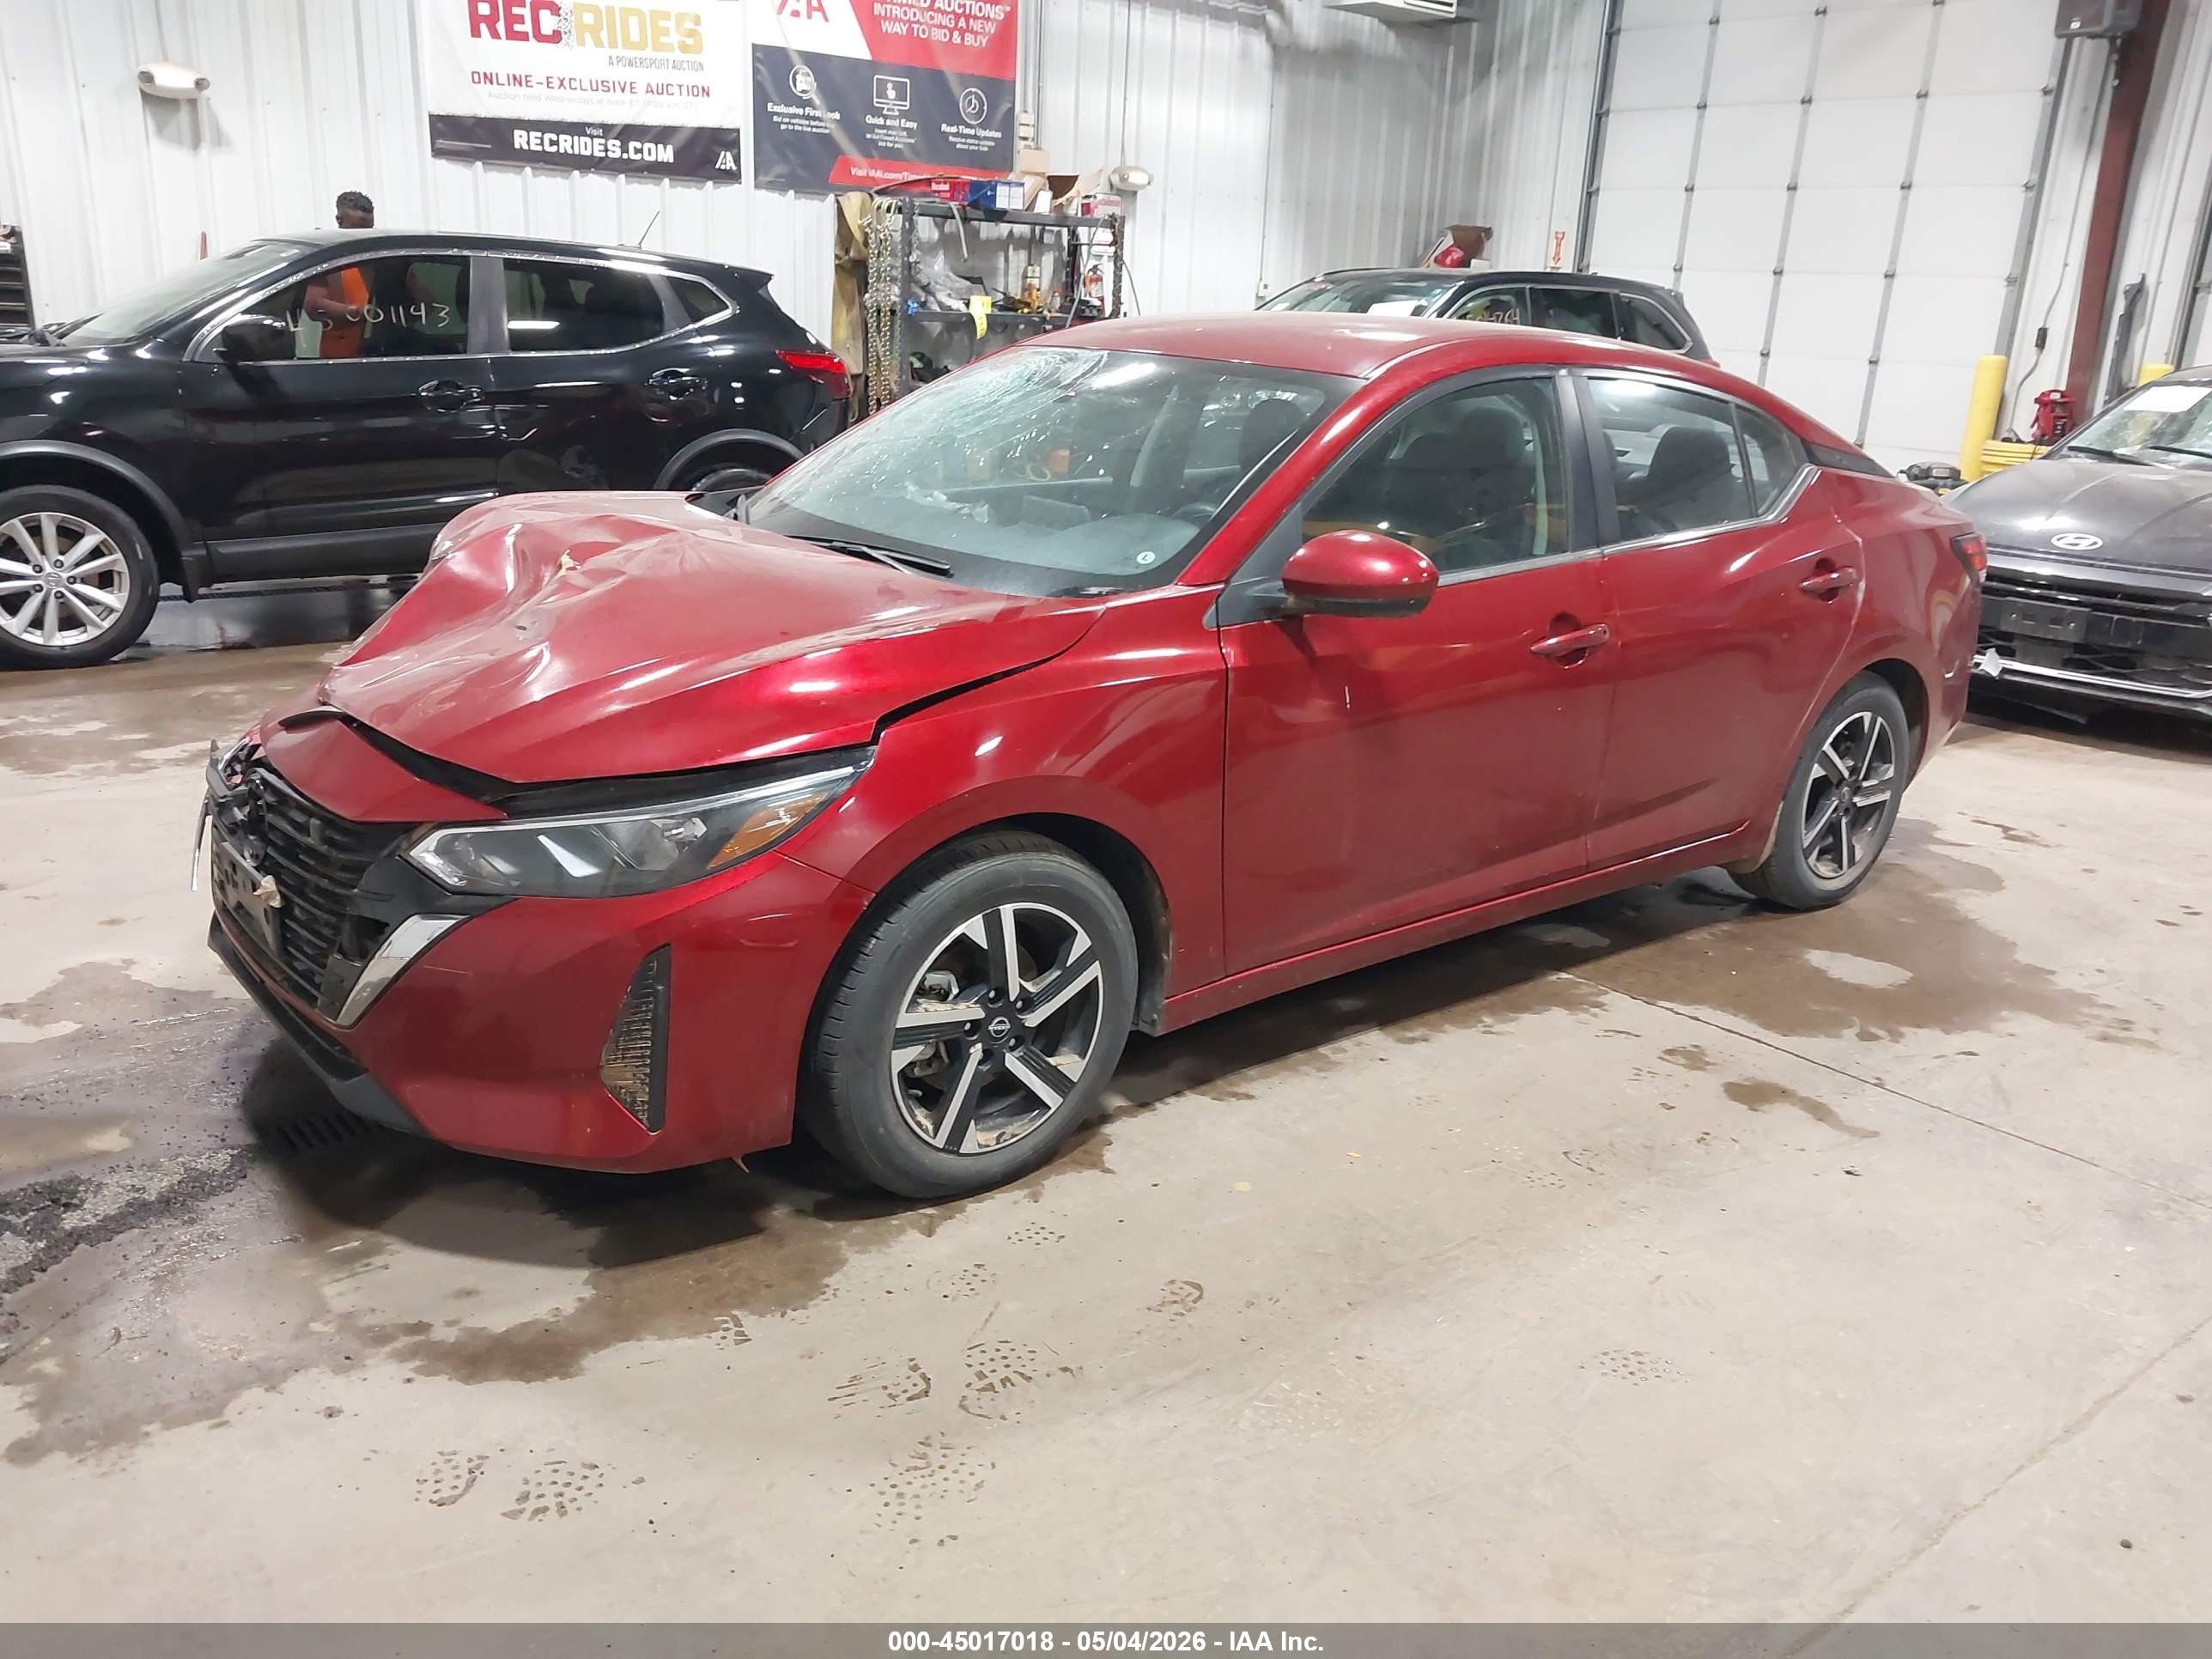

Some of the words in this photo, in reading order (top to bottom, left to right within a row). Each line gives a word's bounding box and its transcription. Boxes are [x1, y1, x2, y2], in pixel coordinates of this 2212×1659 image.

[468, 0, 563, 44] REC
[574, 3, 704, 55] RIDES
[873, 3, 955, 30] INTRODUCING
[957, 17, 967, 29] A
[969, 19, 996, 33] NEW
[881, 19, 908, 36] WAY
[911, 23, 928, 39] TO
[931, 27, 950, 42] BID
[951, 30, 962, 44] &
[964, 32, 988, 48] BUY
[608, 55, 615, 67] A
[617, 55, 670, 70] POWERSPORT
[672, 59, 704, 72] AUCTION
[471, 70, 638, 94] ONLINE-EXCLUSIVE
[645, 82, 711, 98] AUCTION
[767, 102, 804, 115] Exclusive
[805, 106, 822, 118] First
[585, 126, 604, 137] Visit
[865, 114, 884, 125] Quick
[885, 118, 899, 127] and
[900, 118, 918, 130] Easy
[940, 123, 975, 135] Real-Time
[975, 126, 1002, 138] Updates
[513, 129, 674, 164] RECRIDES.COM
